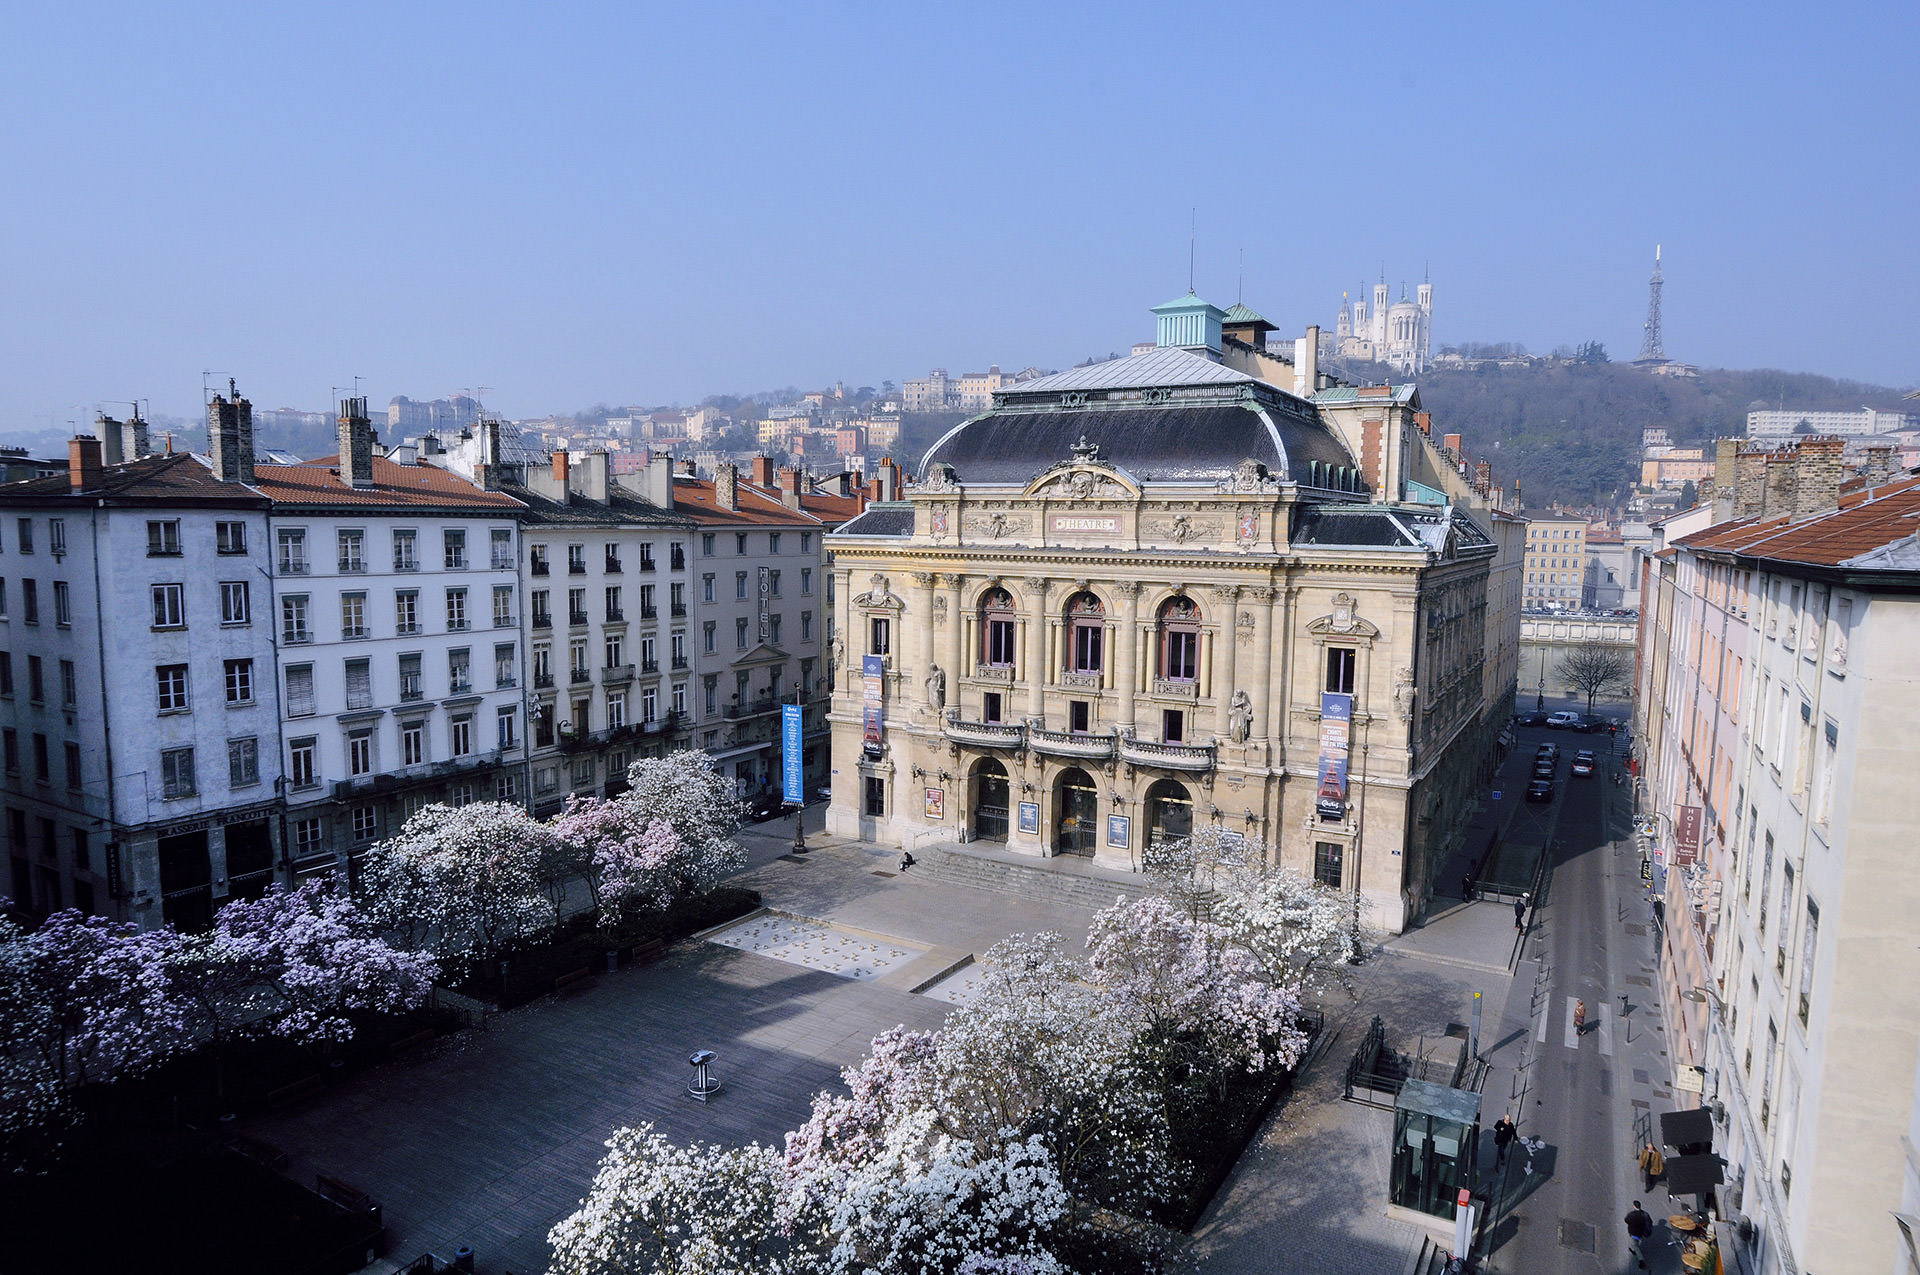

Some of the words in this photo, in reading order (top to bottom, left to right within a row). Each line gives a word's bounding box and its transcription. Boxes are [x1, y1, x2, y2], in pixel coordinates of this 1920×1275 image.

[1063, 519, 1107, 529] THEATRE
[759, 568, 769, 637] HOTEL
[157, 820, 209, 837] BRASSERIE
[216, 808, 276, 826] FRANCOTTE
[1685, 808, 1694, 843] HOTEL
